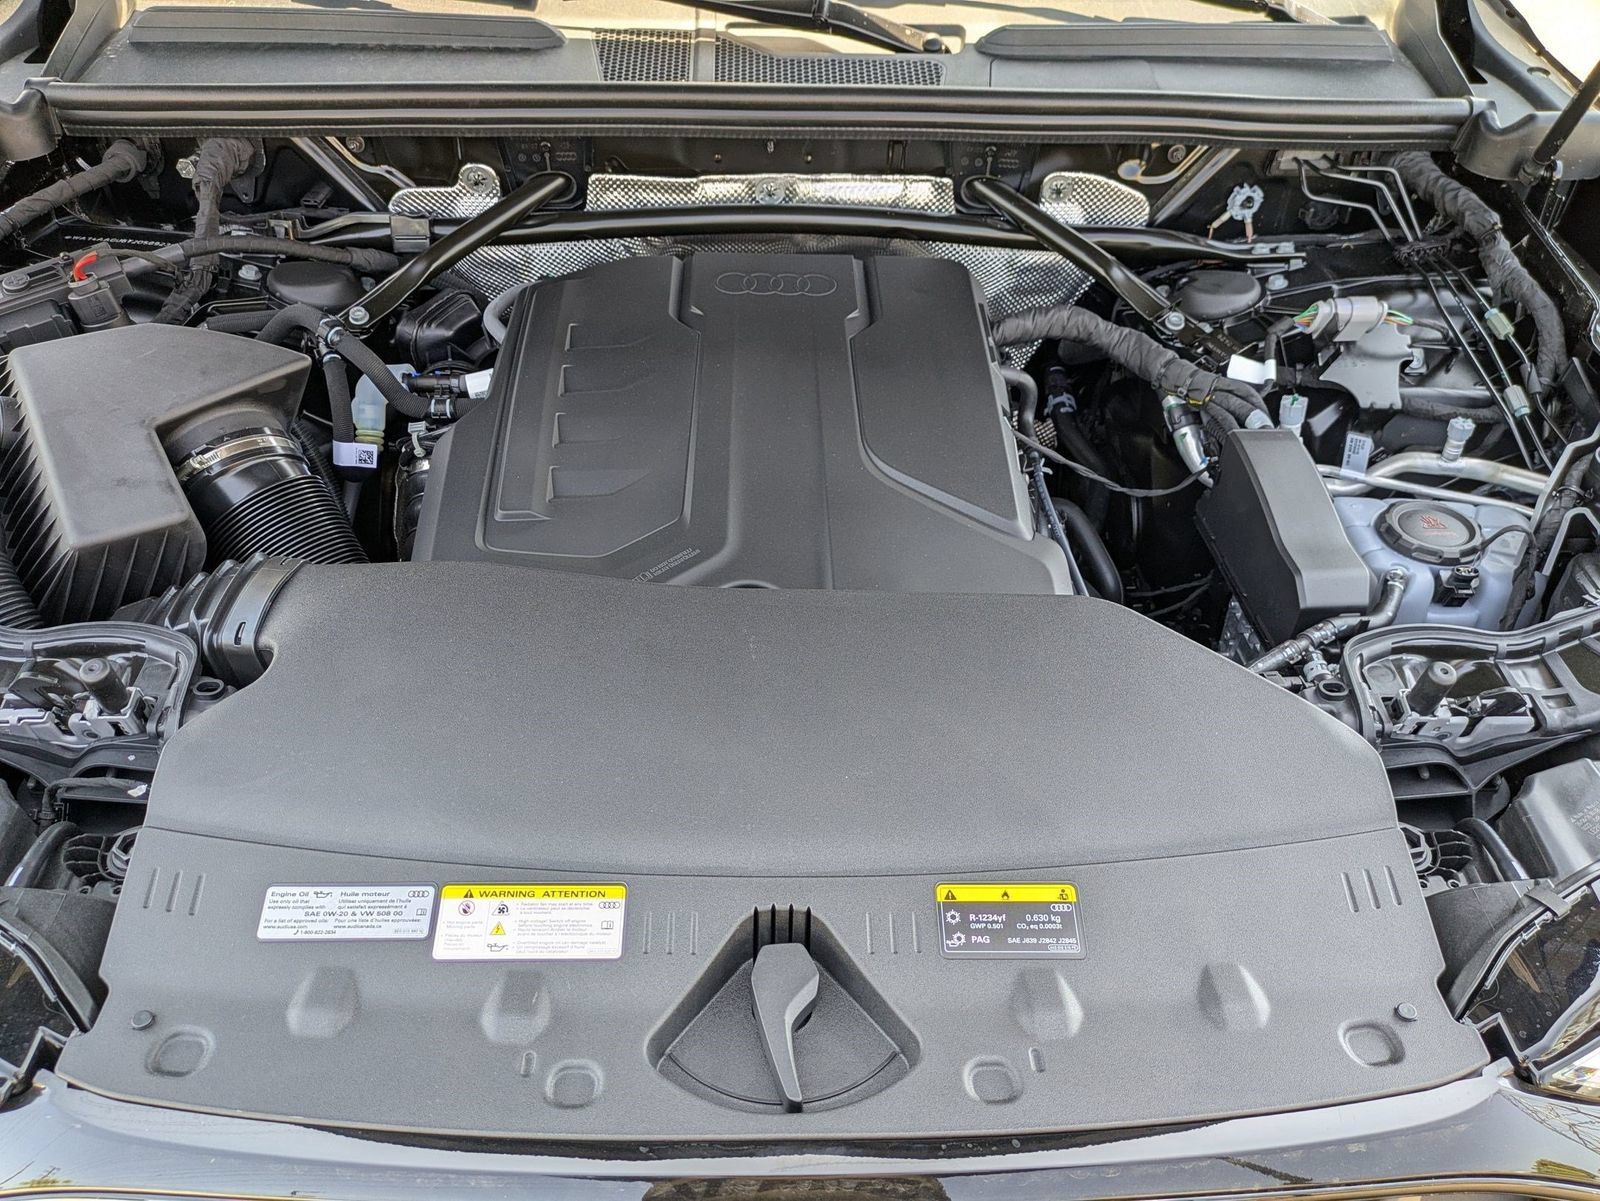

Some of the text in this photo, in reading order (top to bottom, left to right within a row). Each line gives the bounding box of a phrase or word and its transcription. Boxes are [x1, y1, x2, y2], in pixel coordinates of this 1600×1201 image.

[969, 914, 1006, 922] R-1234yf
[1025, 914, 1061, 923] 0.630 kg
